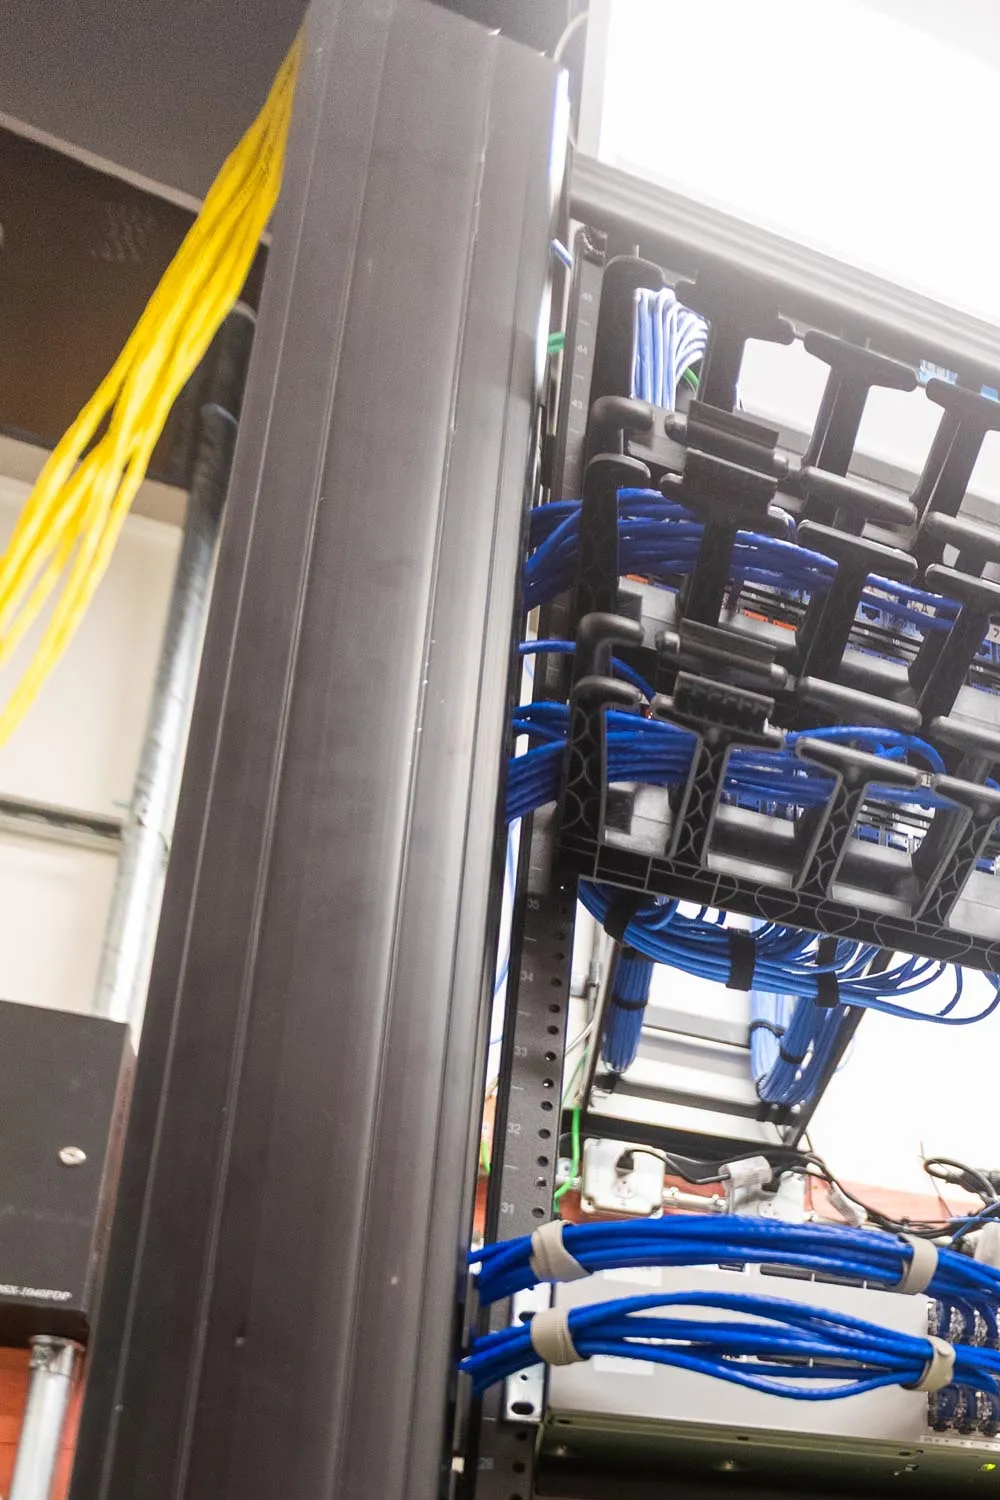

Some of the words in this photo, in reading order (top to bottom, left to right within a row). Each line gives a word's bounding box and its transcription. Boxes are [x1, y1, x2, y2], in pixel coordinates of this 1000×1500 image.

[521, 970, 534, 983] 34
[514, 1045, 528, 1057] 33
[508, 1122, 521, 1135] 32
[501, 1203, 514, 1214] 31
[478, 1457, 494, 1470] 28
